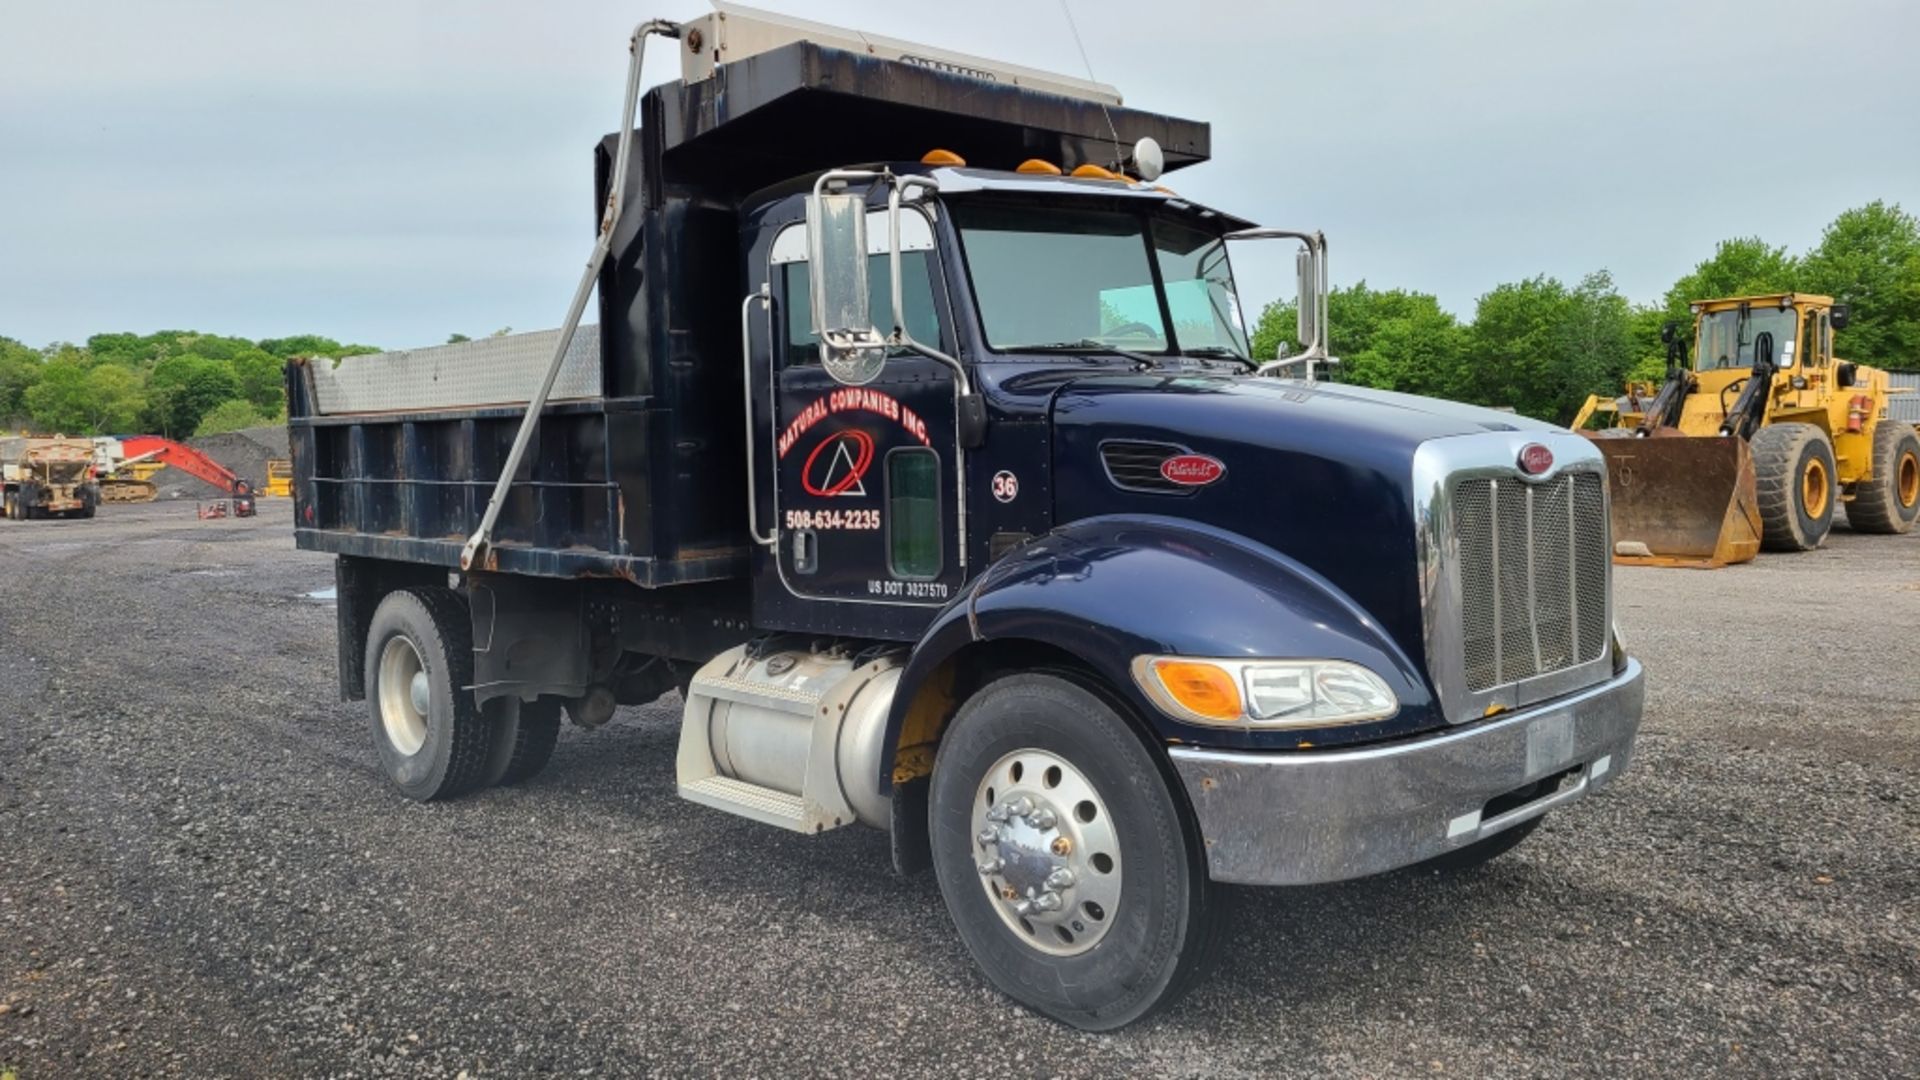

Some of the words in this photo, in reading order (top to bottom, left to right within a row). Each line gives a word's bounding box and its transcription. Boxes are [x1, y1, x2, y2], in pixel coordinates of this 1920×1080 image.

[779, 397, 828, 458] NATURAL
[830, 388, 899, 420] COMPANIES
[994, 476, 1014, 496] 36
[786, 510, 881, 530] 508-634-2235
[868, 580, 881, 594] US
[885, 582, 902, 595] DOT
[907, 583, 948, 598] 3027570
